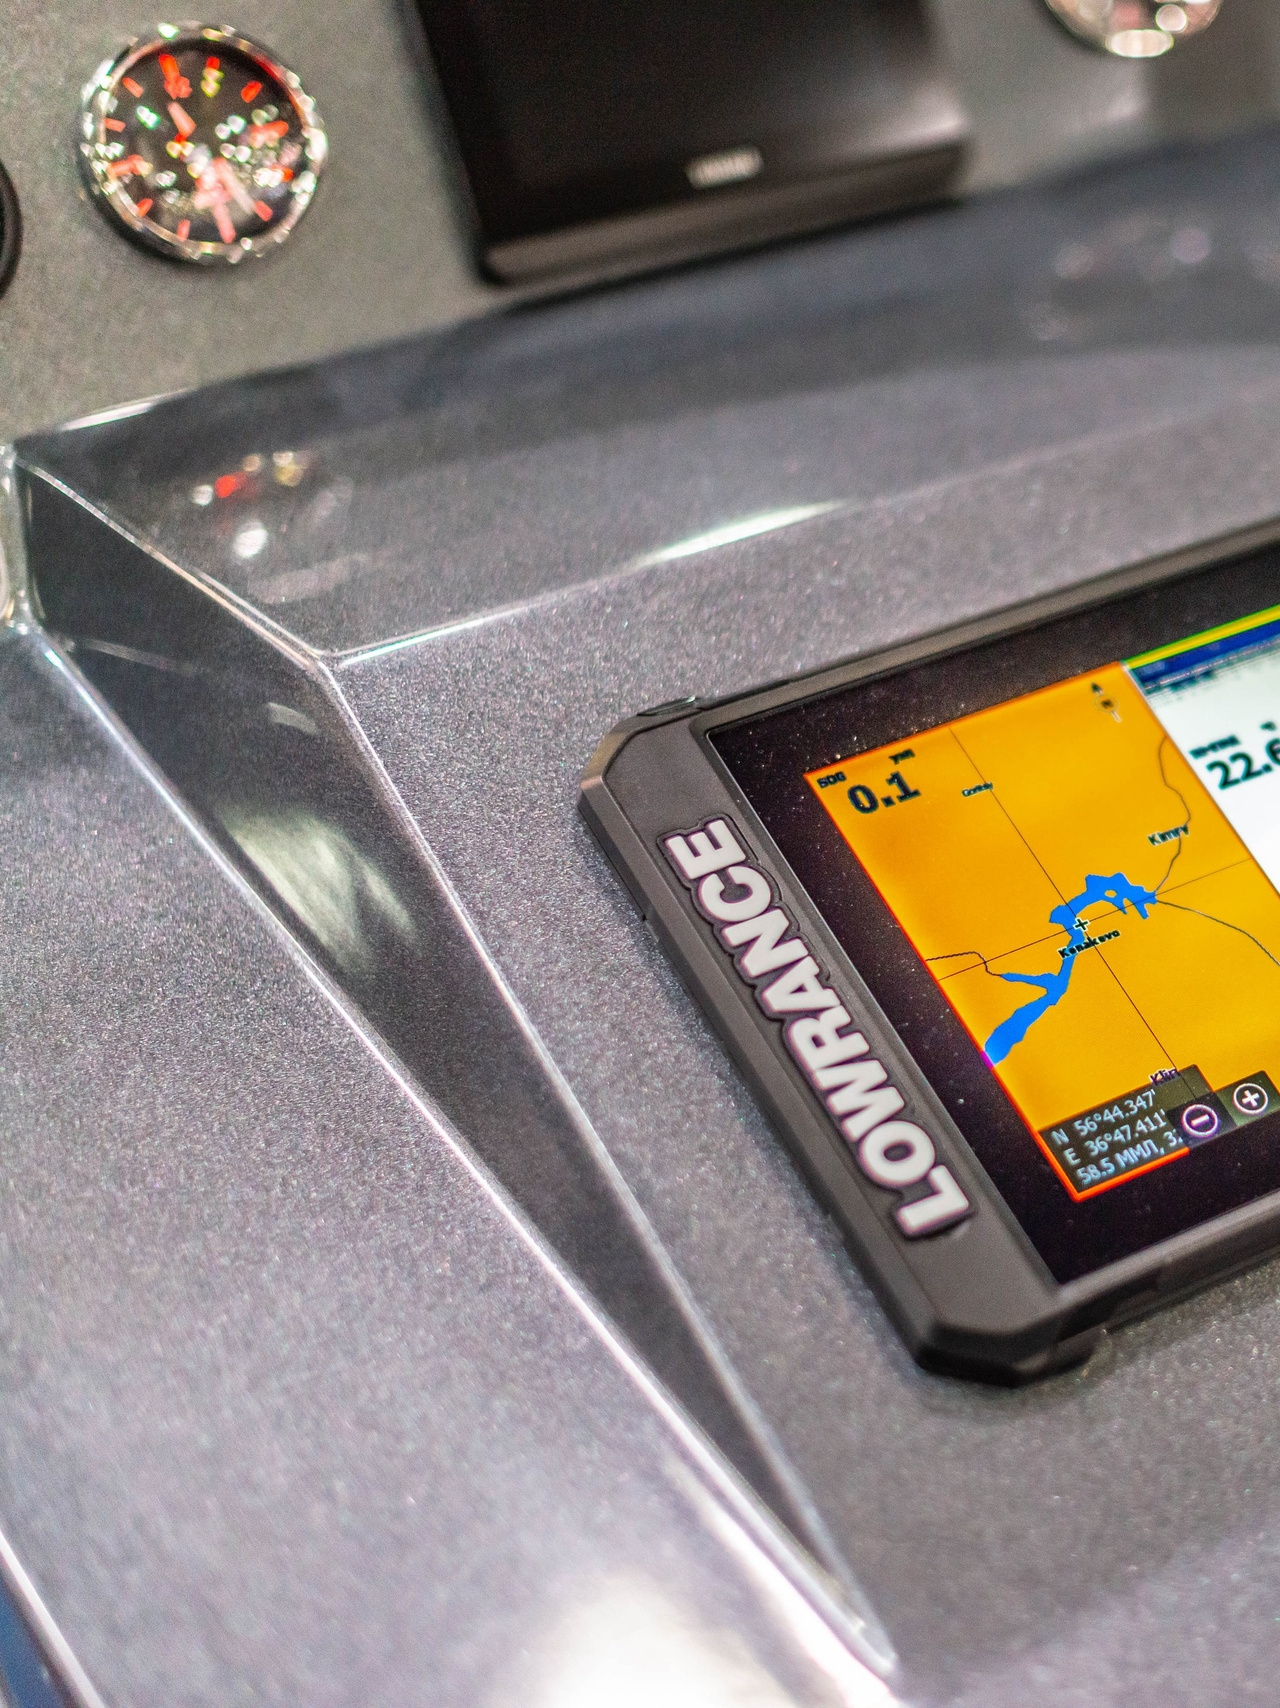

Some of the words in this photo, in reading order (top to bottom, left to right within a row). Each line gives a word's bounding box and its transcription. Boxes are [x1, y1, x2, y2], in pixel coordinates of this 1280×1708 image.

[816, 771, 847, 789] SOG
[847, 770, 921, 813] 0.1
[1147, 823, 1190, 846] Kimry
[664, 818, 970, 1236] LOWRANCE
[1050, 1127, 1070, 1146] N
[1063, 1146, 1081, 1166] E
[1076, 1157, 1116, 1185] 58.5
